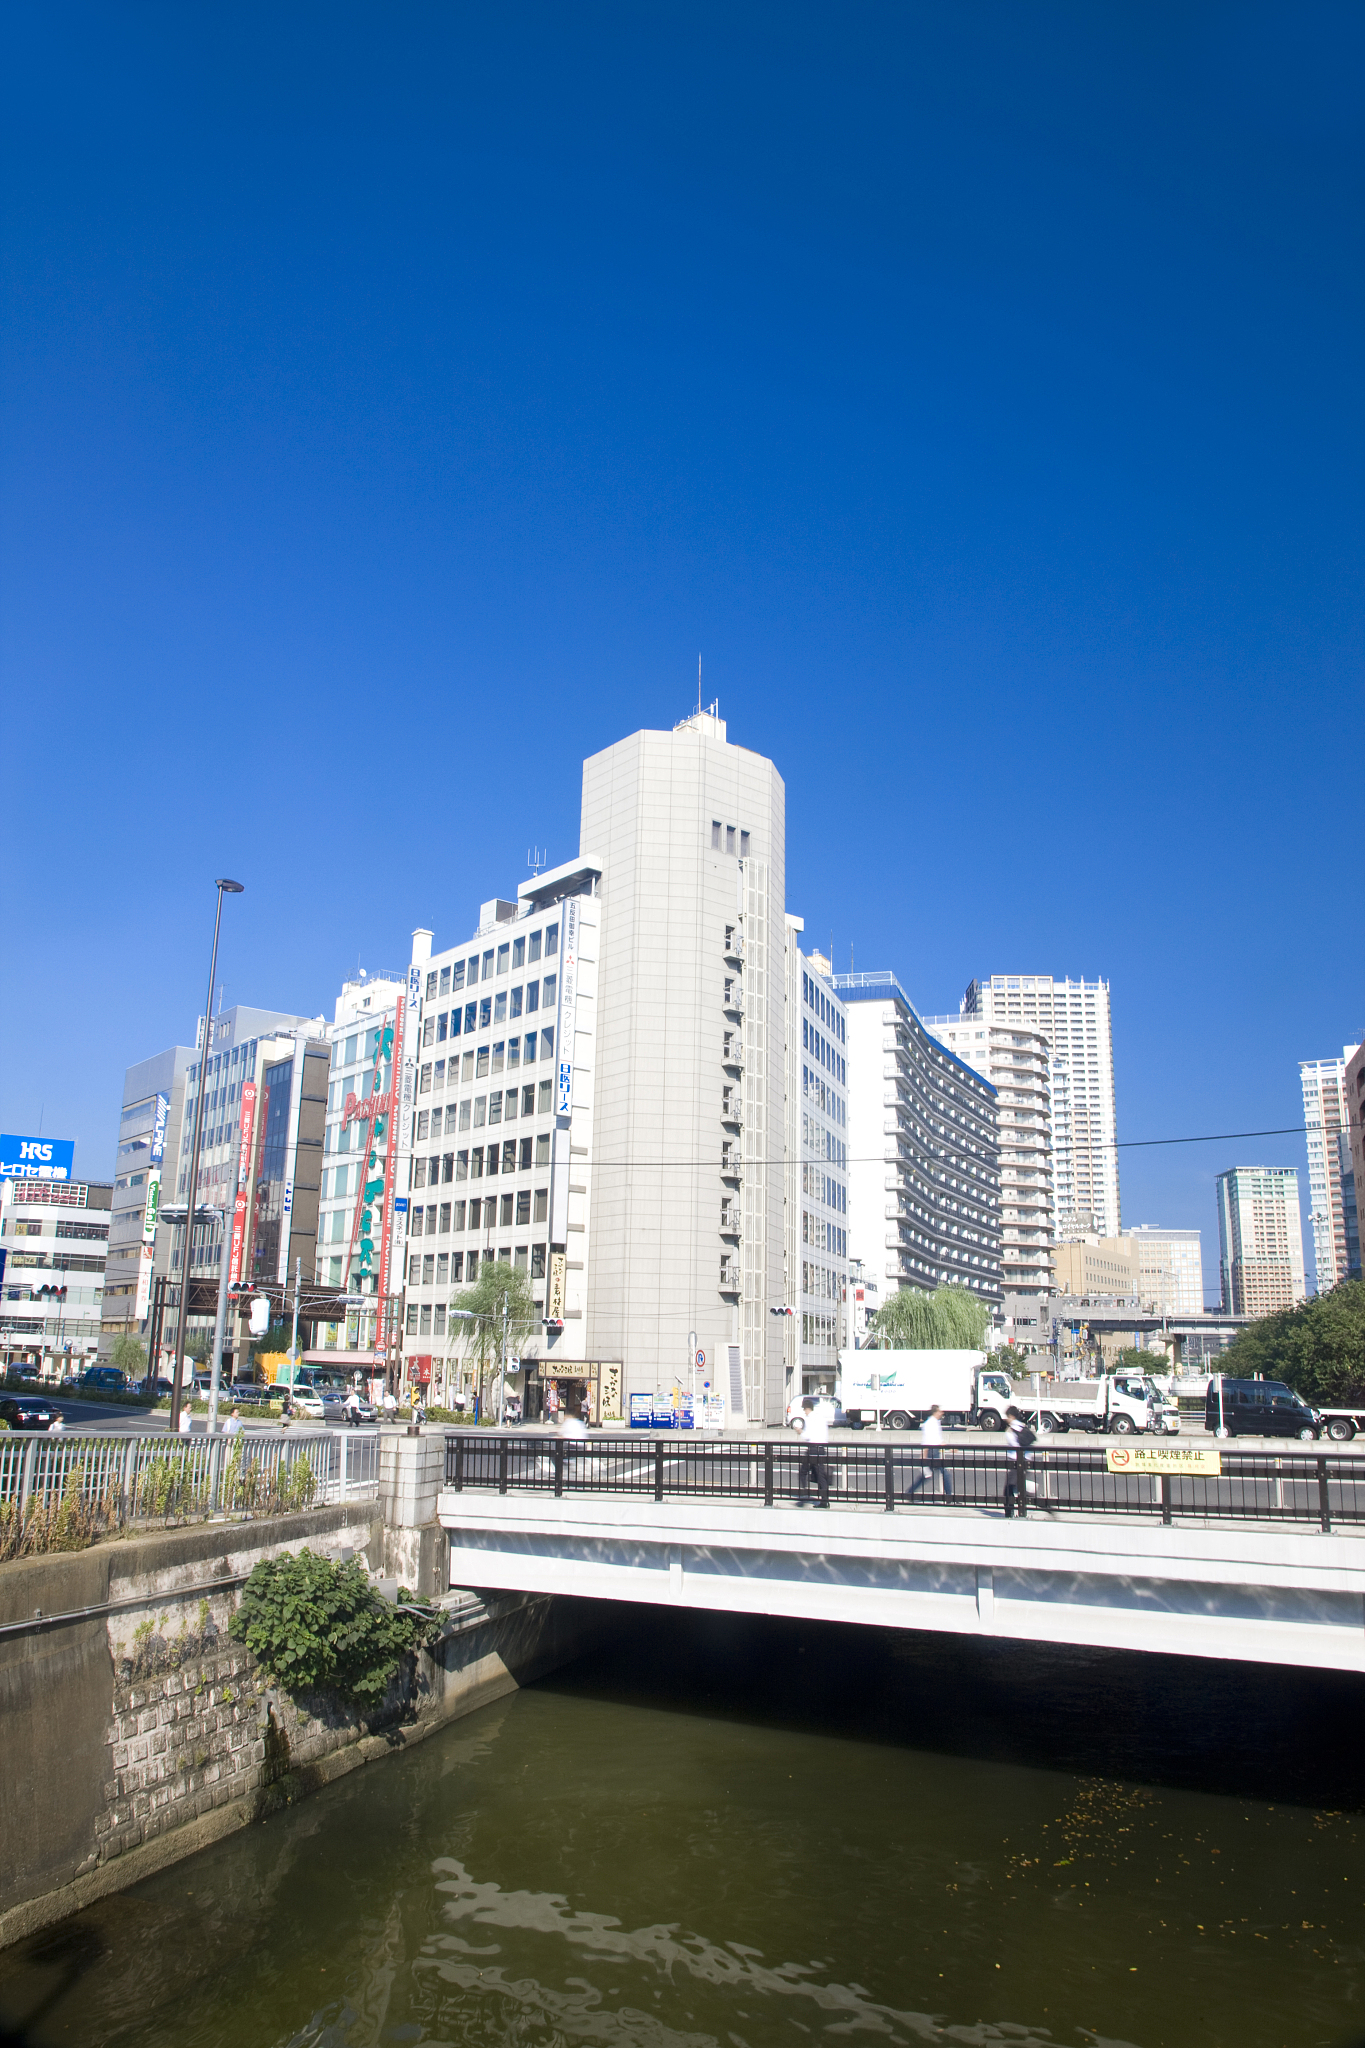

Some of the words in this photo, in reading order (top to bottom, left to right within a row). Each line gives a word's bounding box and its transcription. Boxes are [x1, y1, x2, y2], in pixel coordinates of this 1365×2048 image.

[559, 1063, 571, 1112] 日医リース
[152, 1118, 166, 1157] ALPINE
[19, 1142, 54, 1161] HRS
[0, 1162, 68, 1179] ヒロセ電機
[1134, 1449, 1205, 1461] 路上喫煙禁止
